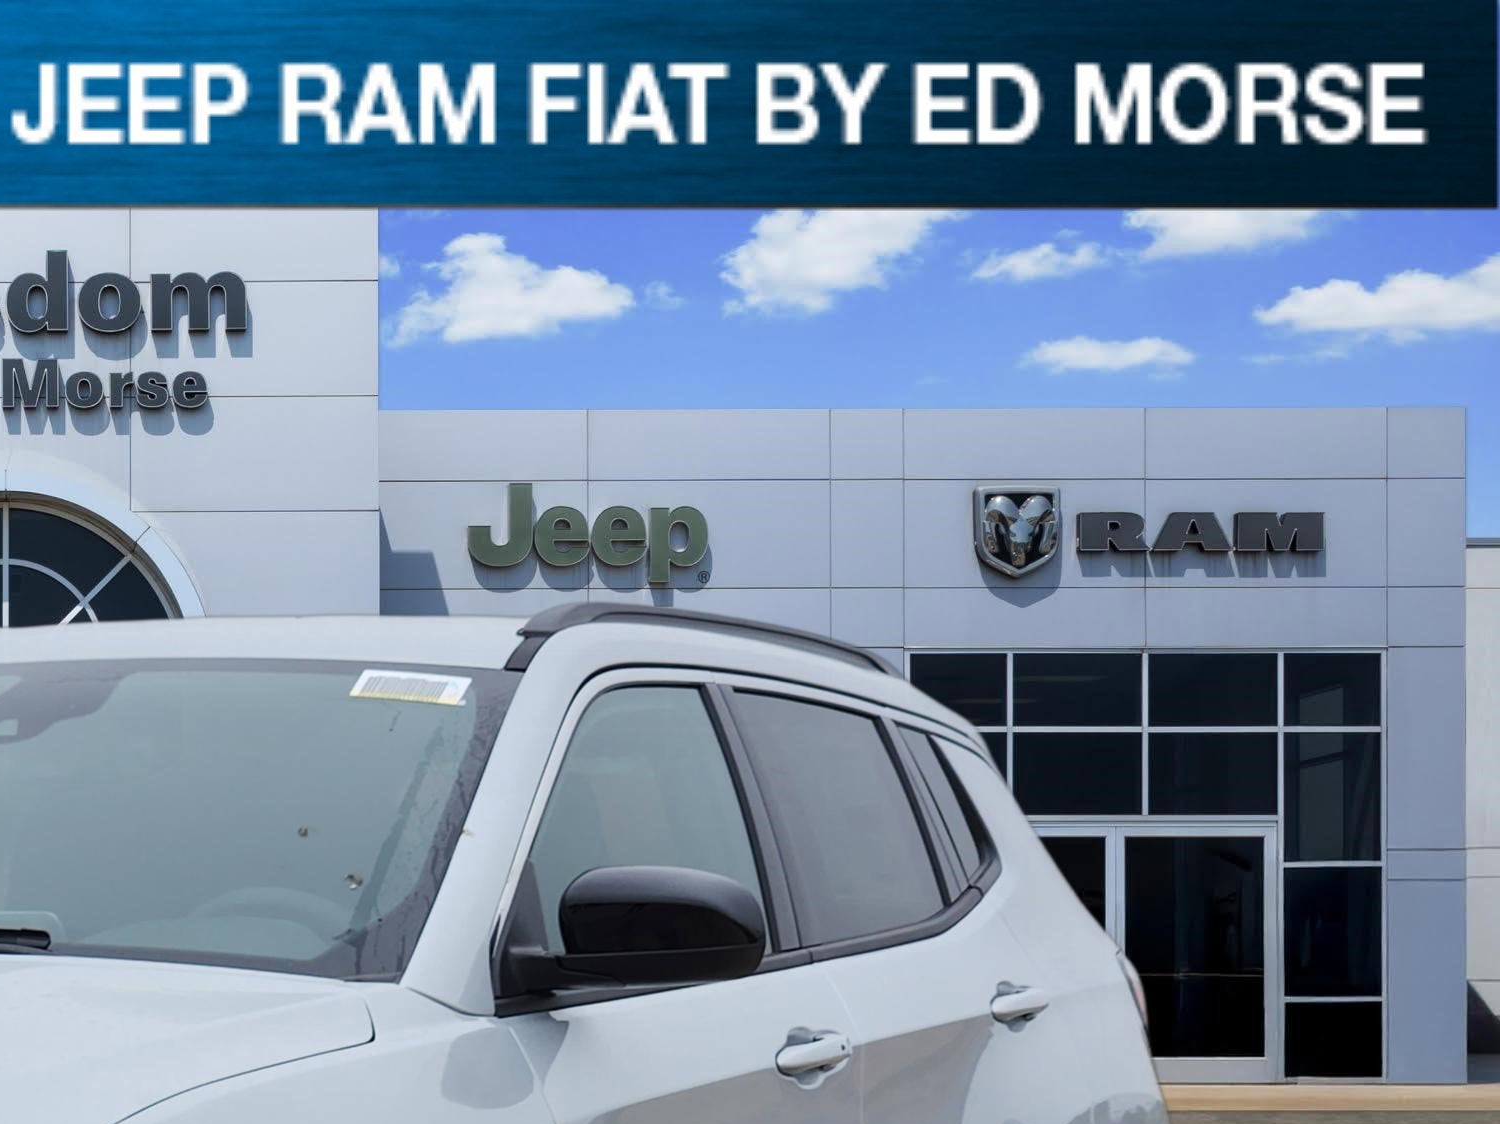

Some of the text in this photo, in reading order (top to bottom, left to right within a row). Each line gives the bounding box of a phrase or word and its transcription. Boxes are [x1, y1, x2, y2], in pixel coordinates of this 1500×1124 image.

[1, 358, 208, 409] Morse
[467, 483, 709, 584] Jeep
[1075, 511, 1326, 553] RAM
